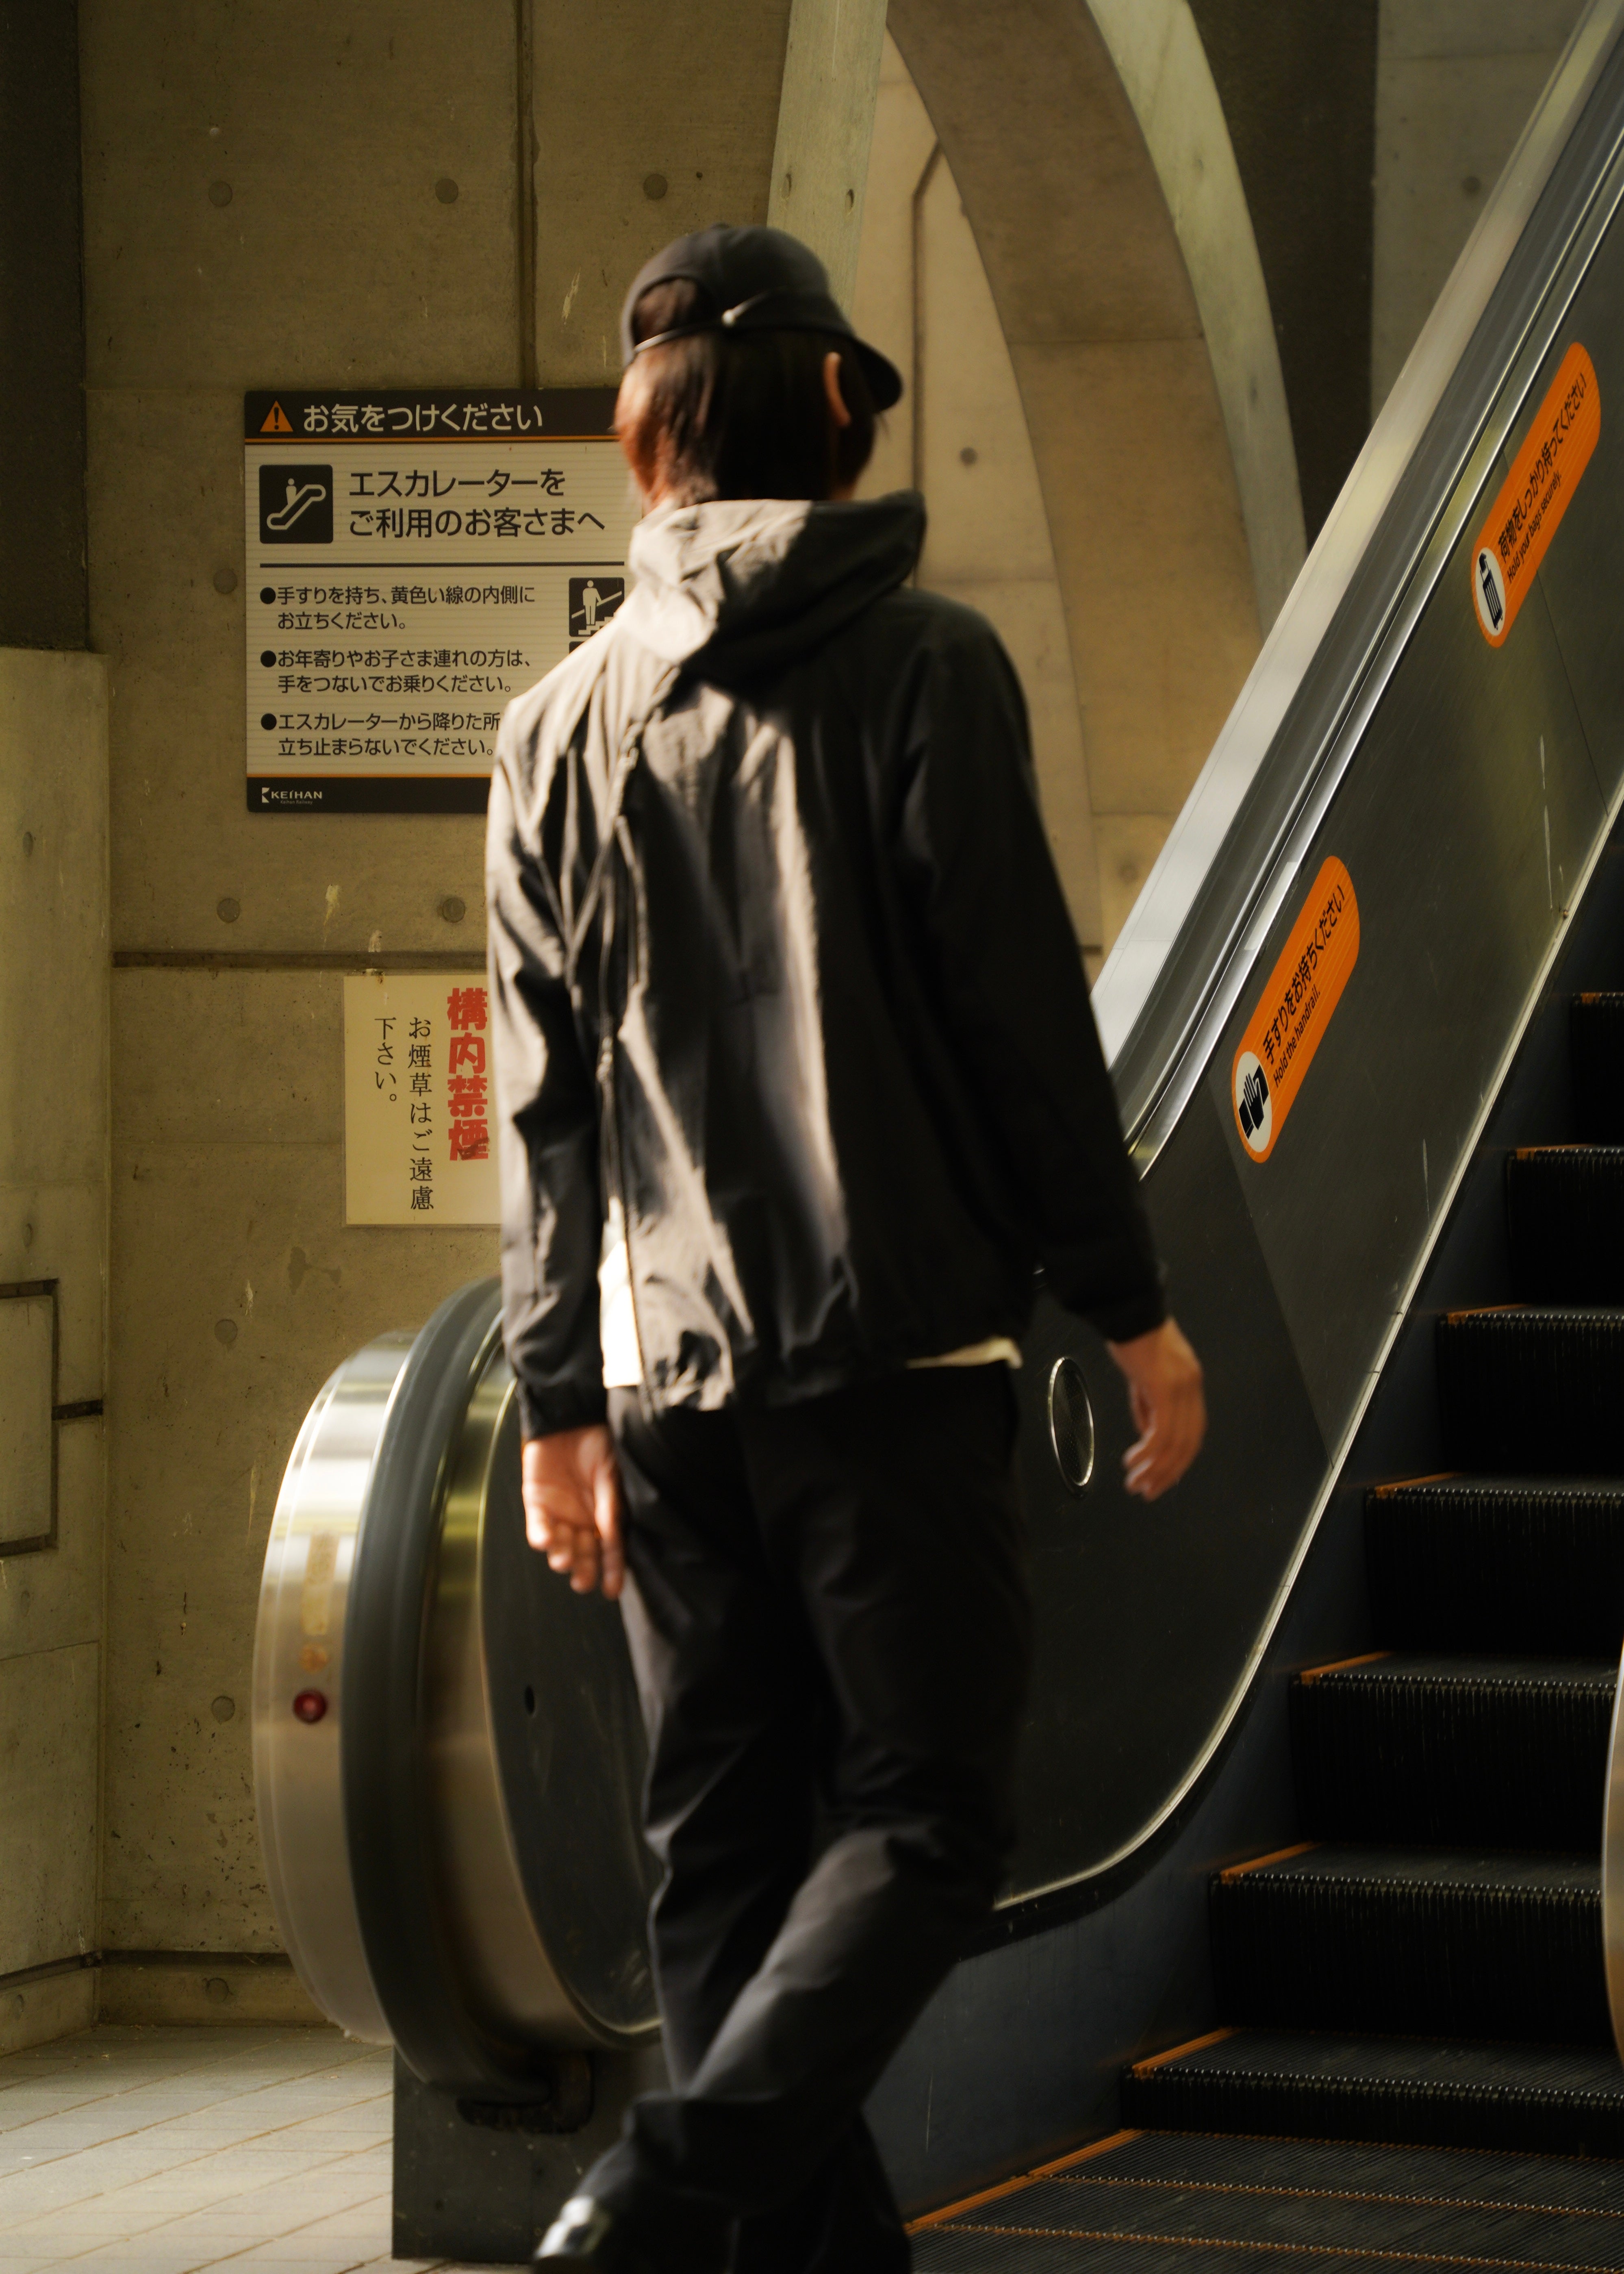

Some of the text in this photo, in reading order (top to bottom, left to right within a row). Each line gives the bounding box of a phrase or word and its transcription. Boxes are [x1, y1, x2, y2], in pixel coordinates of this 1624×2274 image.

[303, 403, 543, 433] お気をつけください
[1498, 372, 1587, 563] 荷物をしっかり持ってください
[350, 470, 565, 497] エスカレーターを
[350, 508, 605, 538] ご利用のお客さまへ
[1507, 470, 1562, 584] Hold your bags securely.
[278, 586, 535, 605] 手すりを持ち、黄色い線の内側に
[278, 612, 405, 630] お立ちください。
[278, 650, 531, 668] お年寄りやお子さま連れの方は、
[278, 674, 511, 693] 手をつないでお乗りください。
[278, 738, 493, 756] 立ち止まらないでください。
[271, 790, 323, 799] KEIHAN
[1263, 885, 1345, 1065] 手すりをお持ちください
[1273, 983, 1320, 1088] Hold the handrail.
[374, 1017, 397, 1102] 下さい。
[448, 988, 489, 1161] 構内禁煙
[408, 1017, 434, 1210] お煙草はご遠慮
